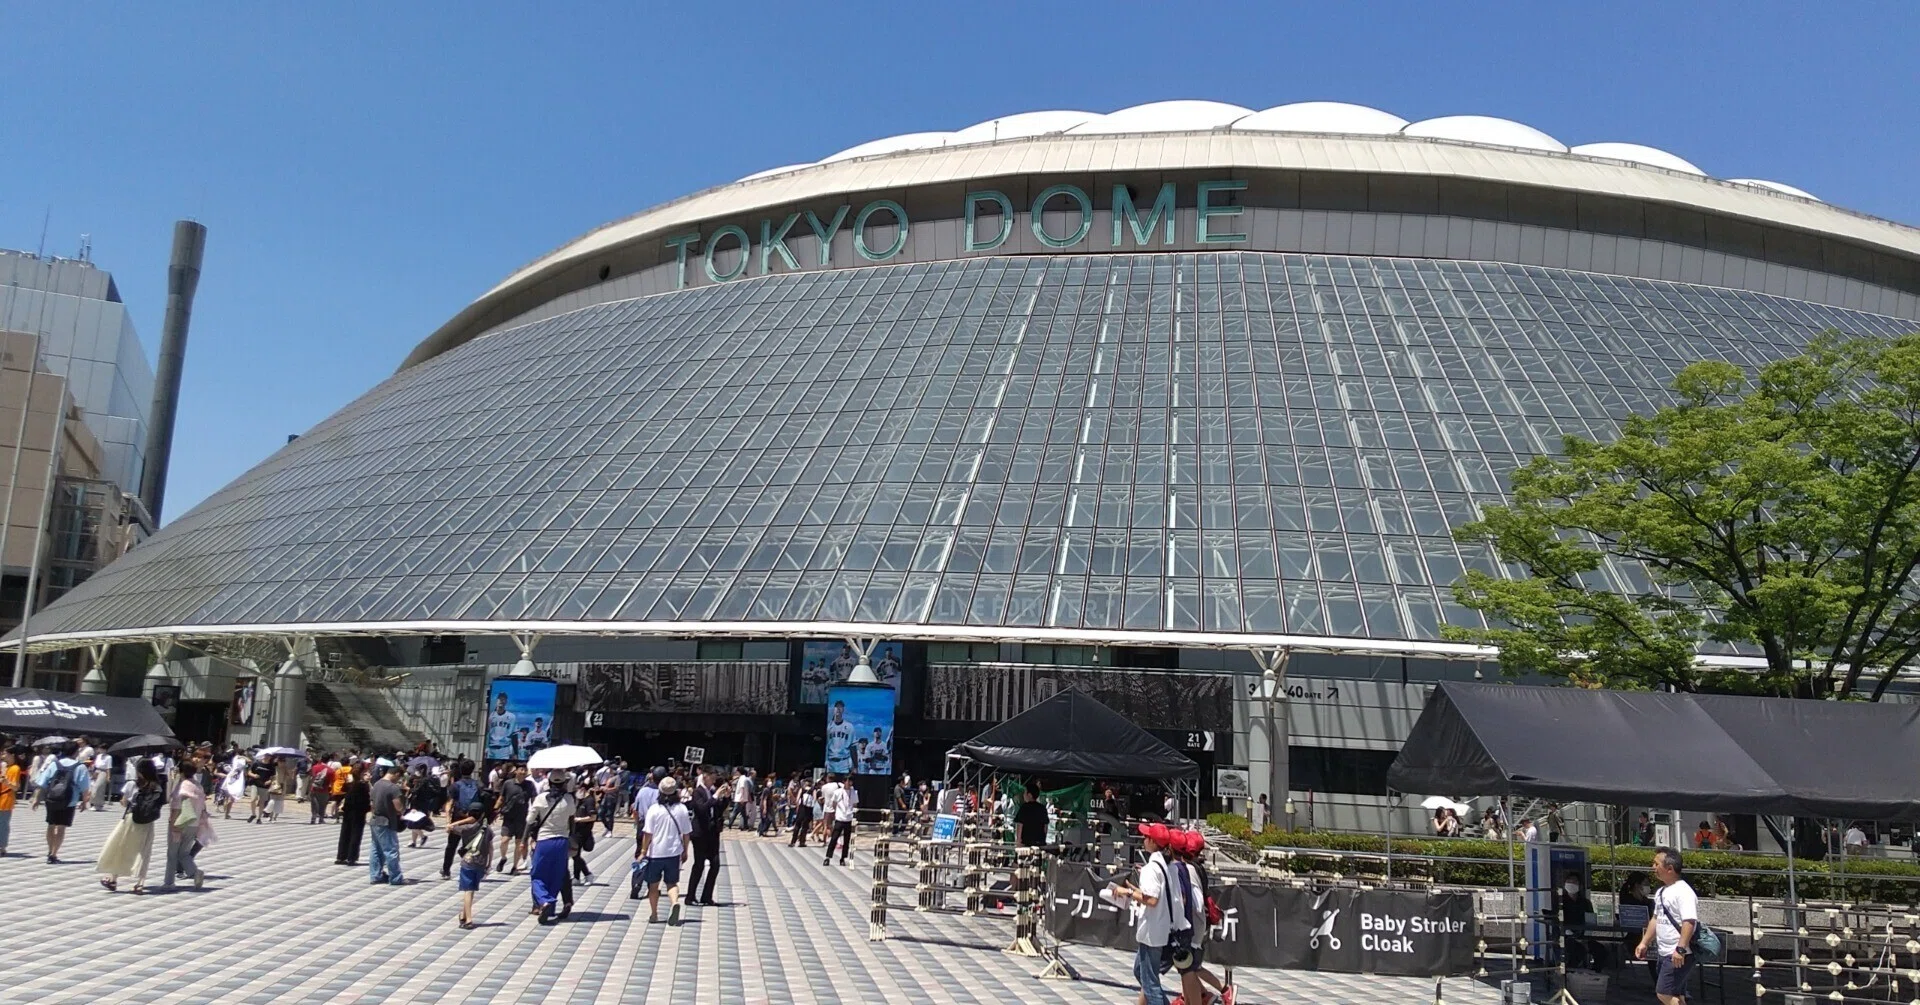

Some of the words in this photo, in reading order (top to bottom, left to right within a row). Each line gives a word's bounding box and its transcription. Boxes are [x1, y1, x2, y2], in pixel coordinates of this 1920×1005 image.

[665, 200, 910, 289] TOKYO
[964, 180, 1249, 253] DOME
[878, 596, 935, 618] WIL
[1304, 692, 1322, 700] GATE
[14, 708, 51, 716] GOODS
[52, 710, 78, 720] SHOP
[51, 700, 108, 717] Park
[593, 713, 604, 722] 23
[1187, 732, 1200, 743] 21
[1360, 913, 1406, 936] Baby
[1411, 916, 1467, 934] Stroler
[1361, 934, 1415, 954] Cloak
